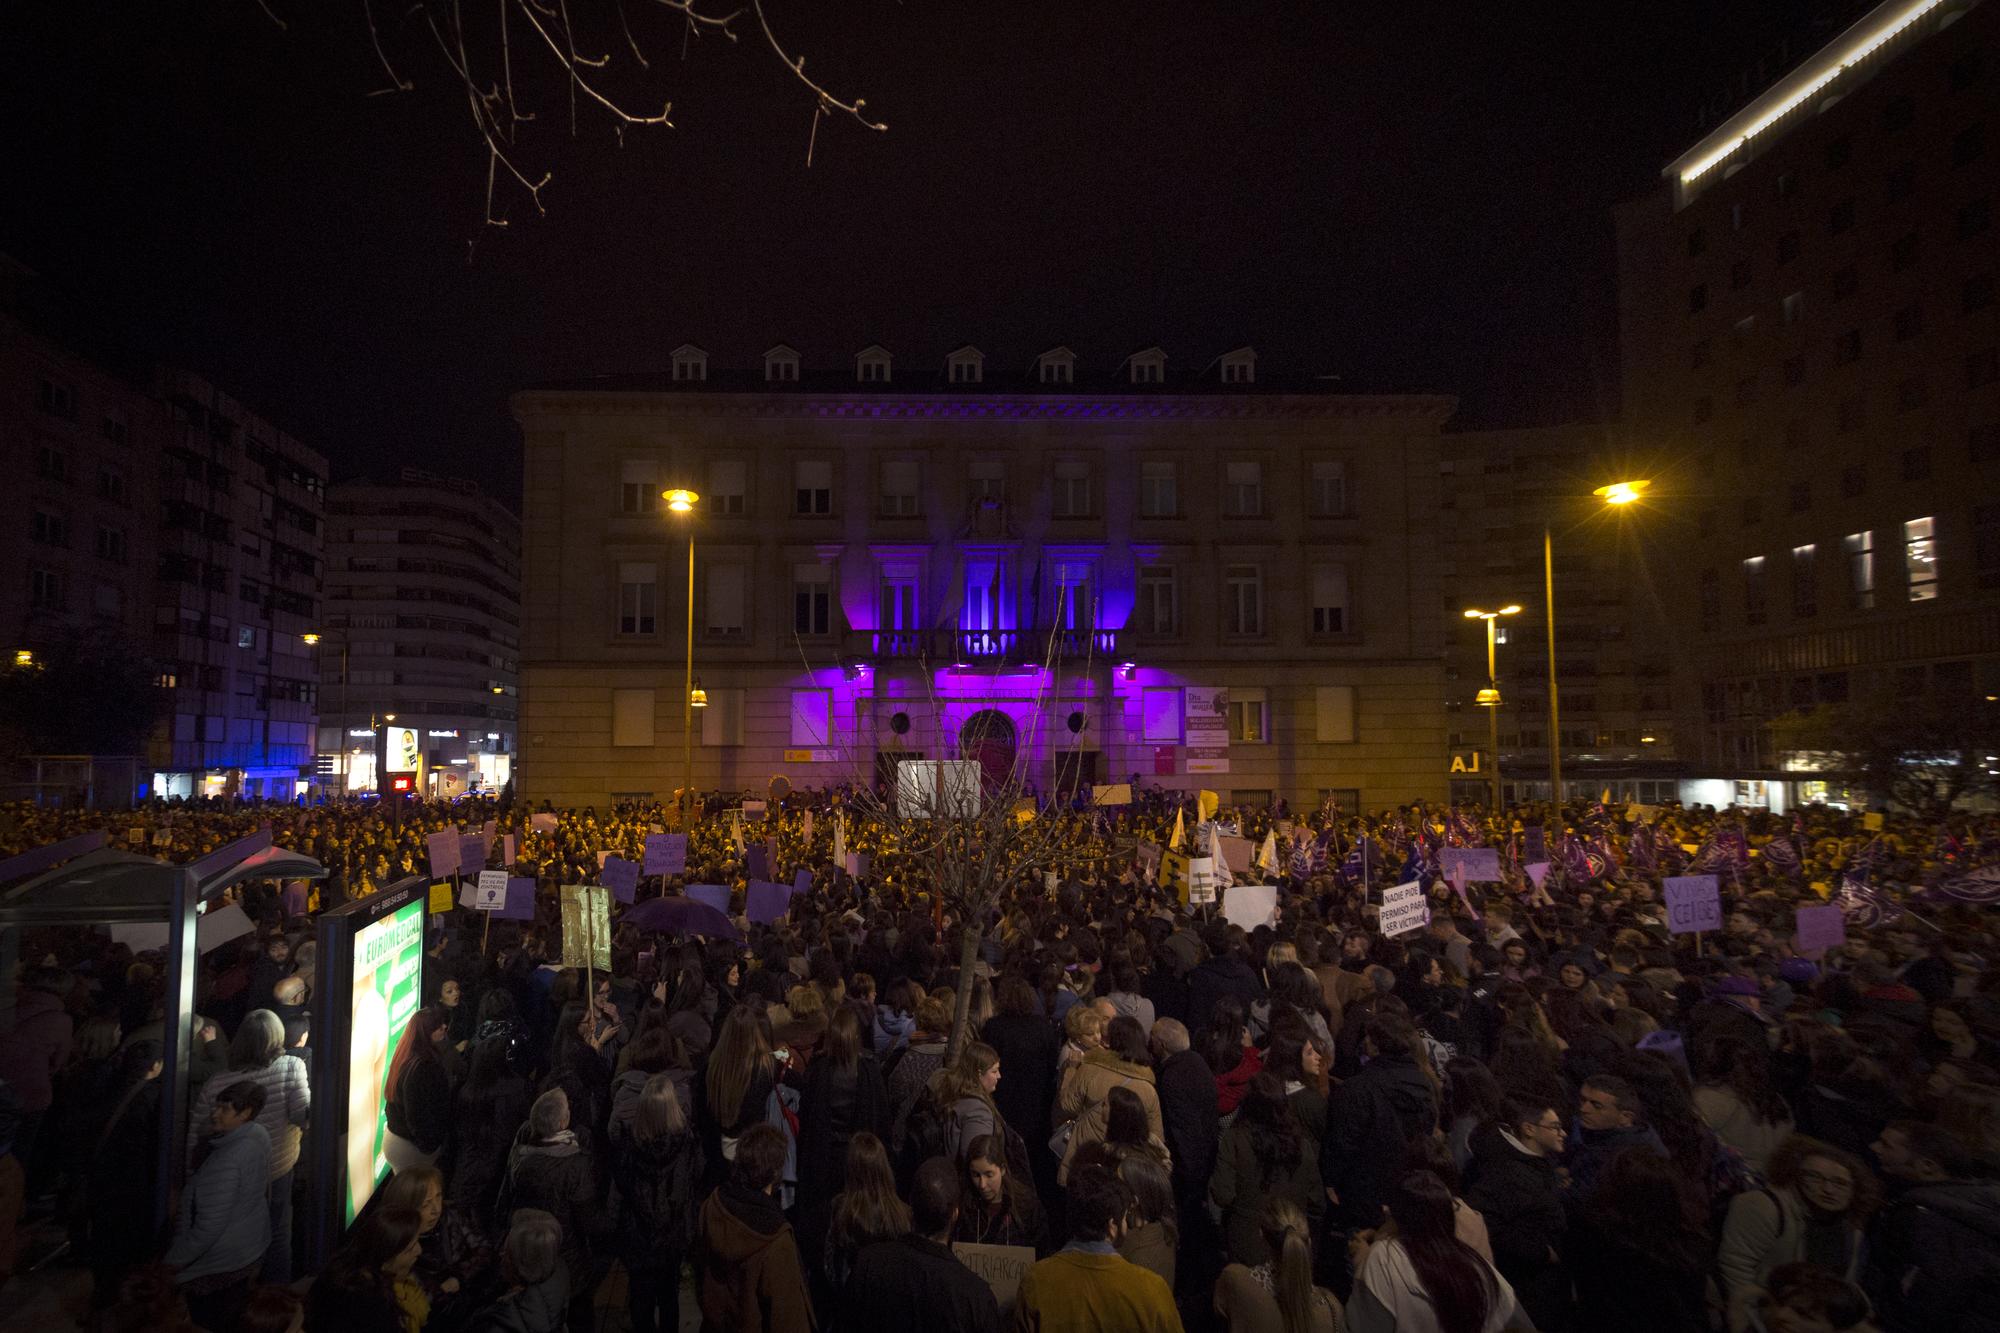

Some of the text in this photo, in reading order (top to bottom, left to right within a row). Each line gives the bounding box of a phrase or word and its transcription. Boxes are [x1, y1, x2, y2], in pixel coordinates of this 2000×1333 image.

[1384, 886, 1418, 904] NADIE PIDE
[1381, 900, 1425, 920] PERMISO PARA
[1386, 920, 1398, 932] SER
[366, 914, 420, 964] EUROMEDICAL
